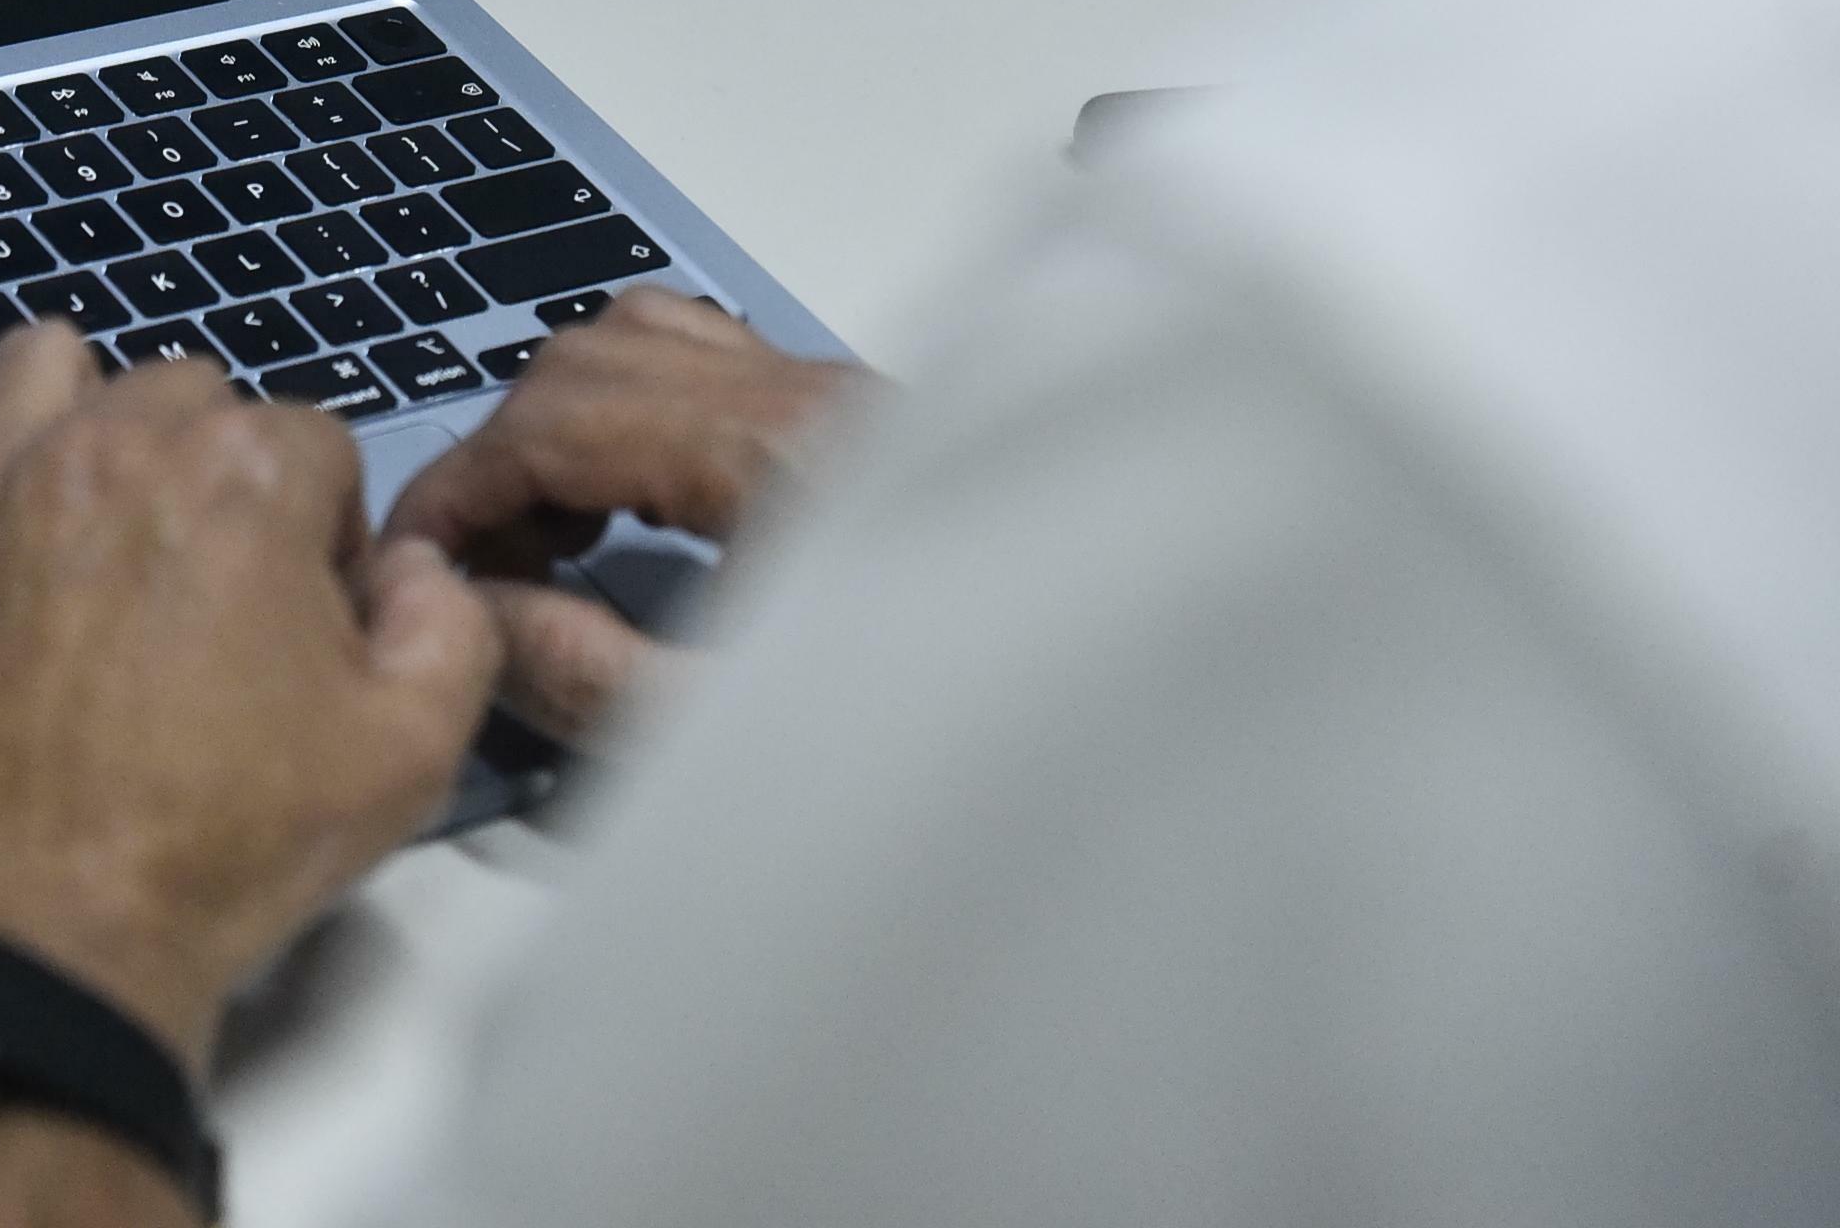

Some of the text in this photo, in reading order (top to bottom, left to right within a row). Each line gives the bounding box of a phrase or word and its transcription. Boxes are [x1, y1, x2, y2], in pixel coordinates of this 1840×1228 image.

[154, 89, 176, 101] F10
[77, 165, 97, 182] 9
[246, 182, 264, 200] P
[162, 201, 184, 218] O
[237, 254, 261, 271] L
[150, 272, 177, 292] K
[410, 270, 430, 290] ?
[69, 293, 85, 313] J
[158, 340, 188, 364] M
